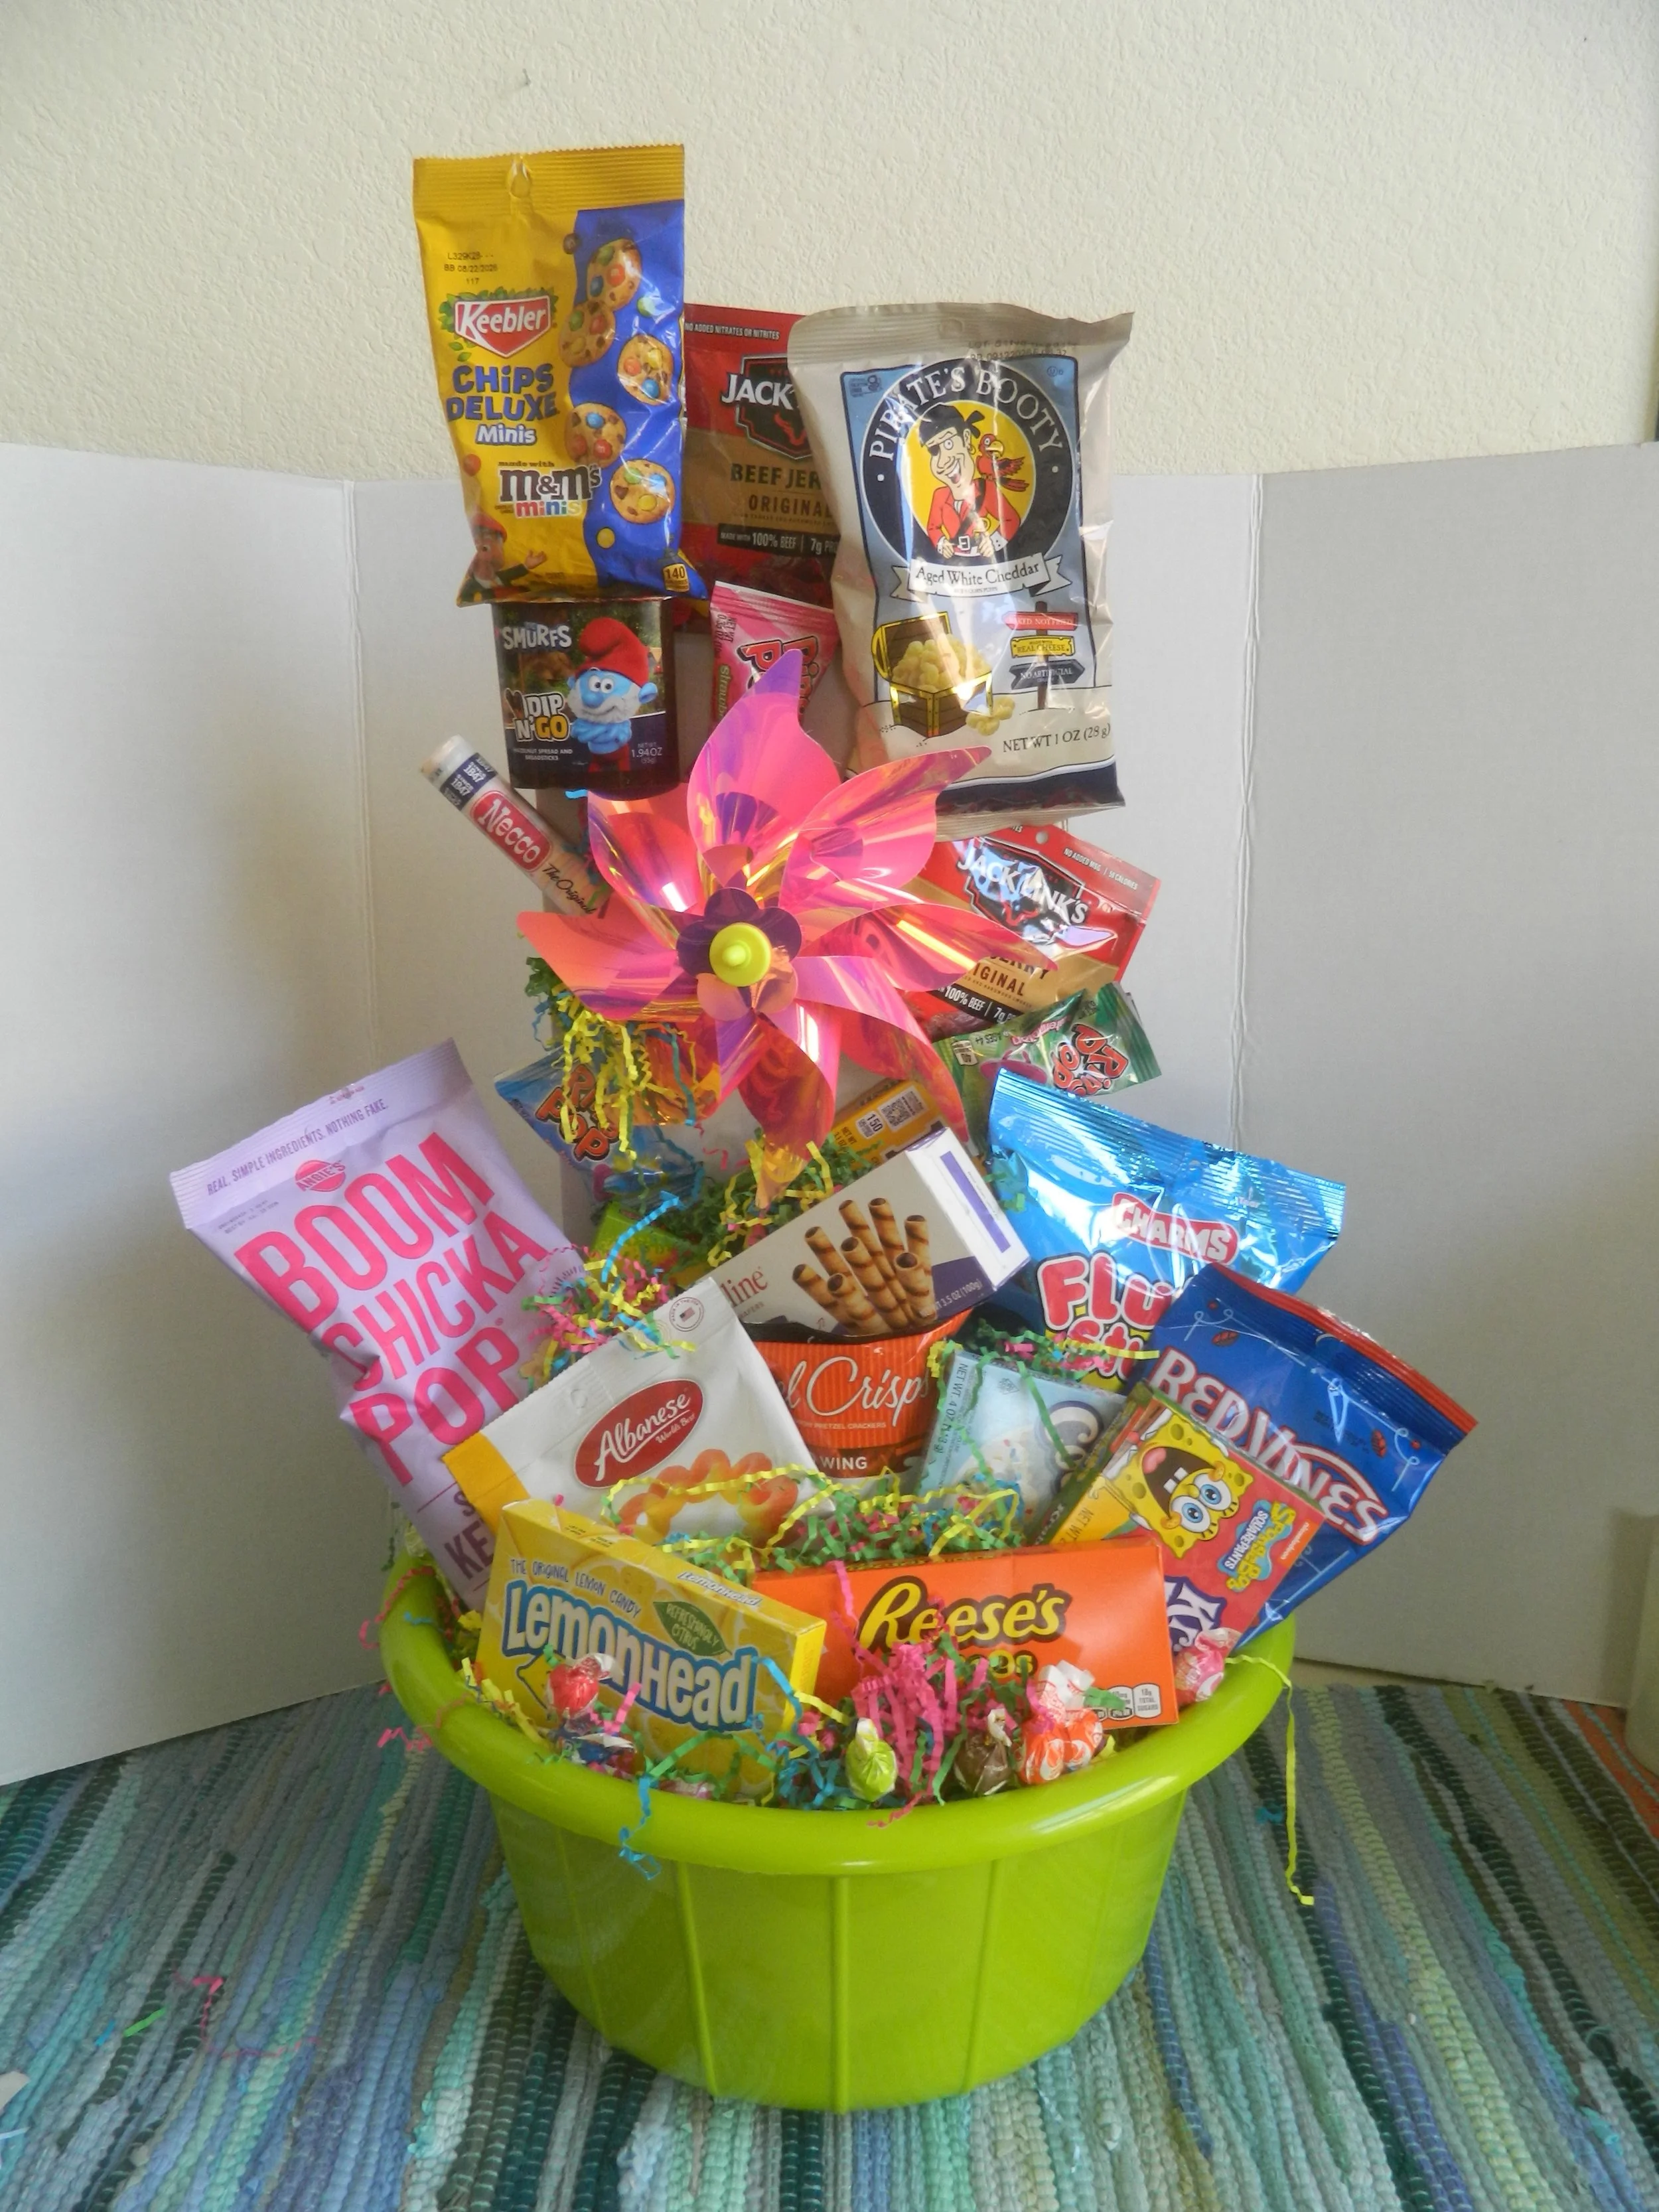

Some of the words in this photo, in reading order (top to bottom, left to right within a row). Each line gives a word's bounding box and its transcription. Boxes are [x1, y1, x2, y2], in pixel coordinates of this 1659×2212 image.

[459, 304, 549, 340] Keebler
[693, 323, 715, 334] ADDED
[715, 325, 743, 337] NITRATES
[753, 328, 780, 340] NITRITES
[446, 391, 560, 422] DELUXE
[869, 366, 966, 462] PIRATE'S
[975, 367, 1063, 452] BOOTY
[475, 423, 538, 446] Minis
[731, 463, 783, 486] BEEF
[785, 469, 823, 490] JER
[515, 500, 582, 518] minis
[751, 531, 779, 549] 100%
[780, 534, 798, 550] BEEF
[810, 537, 823, 555] 7g
[665, 565, 686, 581] 140
[915, 566, 946, 587] Aged
[946, 567, 983, 587] White
[984, 561, 1041, 585] Cheddar
[502, 625, 572, 651] SMURFS
[1037, 642, 1066, 652] CHEESE
[524, 694, 563, 718] DIP
[1002, 737, 1028, 753] NET
[1028, 734, 1053, 750] WT
[1061, 730, 1081, 743] OZ
[477, 798, 541, 863] Necco
[542, 863, 560, 881] The
[1114, 871, 1139, 891] CALORIES
[972, 962, 1025, 997] IGINAL
[944, 985, 969, 1005] 100%
[967, 995, 986, 1012] BEEF
[865, 1111, 884, 1133] 150
[231, 1157, 266, 1183] SIMPLE
[265, 1129, 325, 1167] INGREDIENTS.
[325, 1109, 366, 1137] NOTHING
[297, 1159, 346, 1192] ANGIE'S
[234, 1132, 494, 1334] BOOM
[1113, 1198, 1232, 1261] CHARMS
[321, 1211, 548, 1392] CHICKA
[720, 1267, 768, 1309] line
[954, 1363, 969, 1382] NET
[806, 1355, 929, 1428] Crisps
[348, 1325, 520, 1487] POP
[594, 1390, 692, 1483] Albanese
[820, 1455, 869, 1471] WING
[1076, 1507, 1094, 1526] NET
[1067, 1522, 1084, 1541] WT
[1224, 1510, 1269, 1570] SQUAREPANTS
[510, 1558, 528, 1577] THE
[532, 1560, 569, 1584] ORIGINAL
[575, 1570, 607, 1596] LEMON
[609, 1586, 642, 1619] CANDY
[665, 1600, 721, 1647] REFRESHINGLY
[859, 1581, 1066, 1654] Reese's
[670, 1621, 699, 1651] CITRUS
